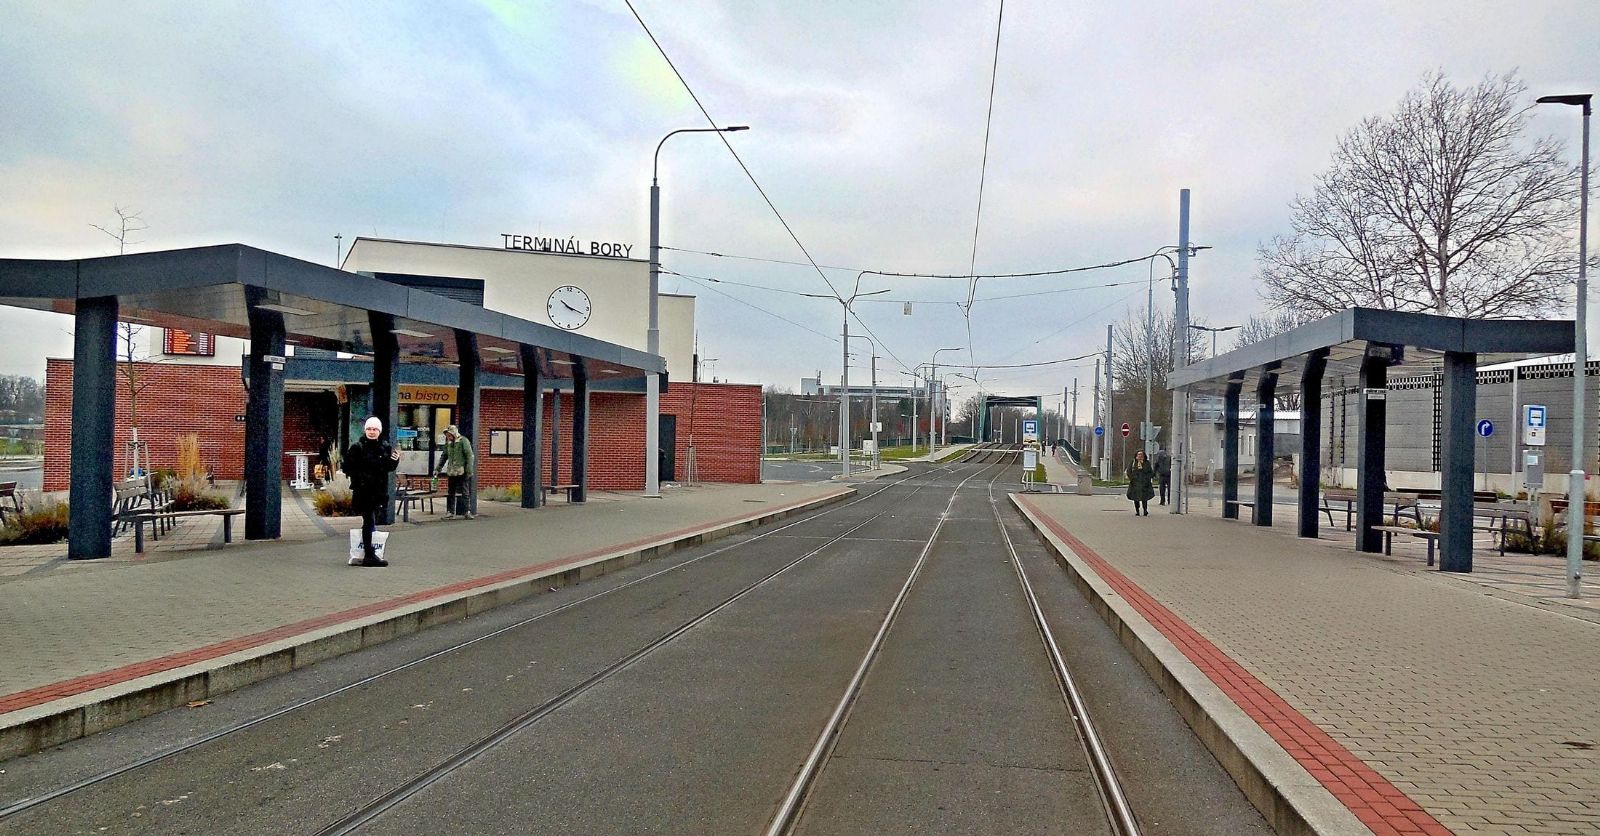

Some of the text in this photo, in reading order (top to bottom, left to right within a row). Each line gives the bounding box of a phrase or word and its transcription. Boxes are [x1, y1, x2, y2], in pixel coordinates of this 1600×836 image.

[501, 233, 633, 259] TERMINÁL BORY
[398, 389, 450, 401] na bistro
